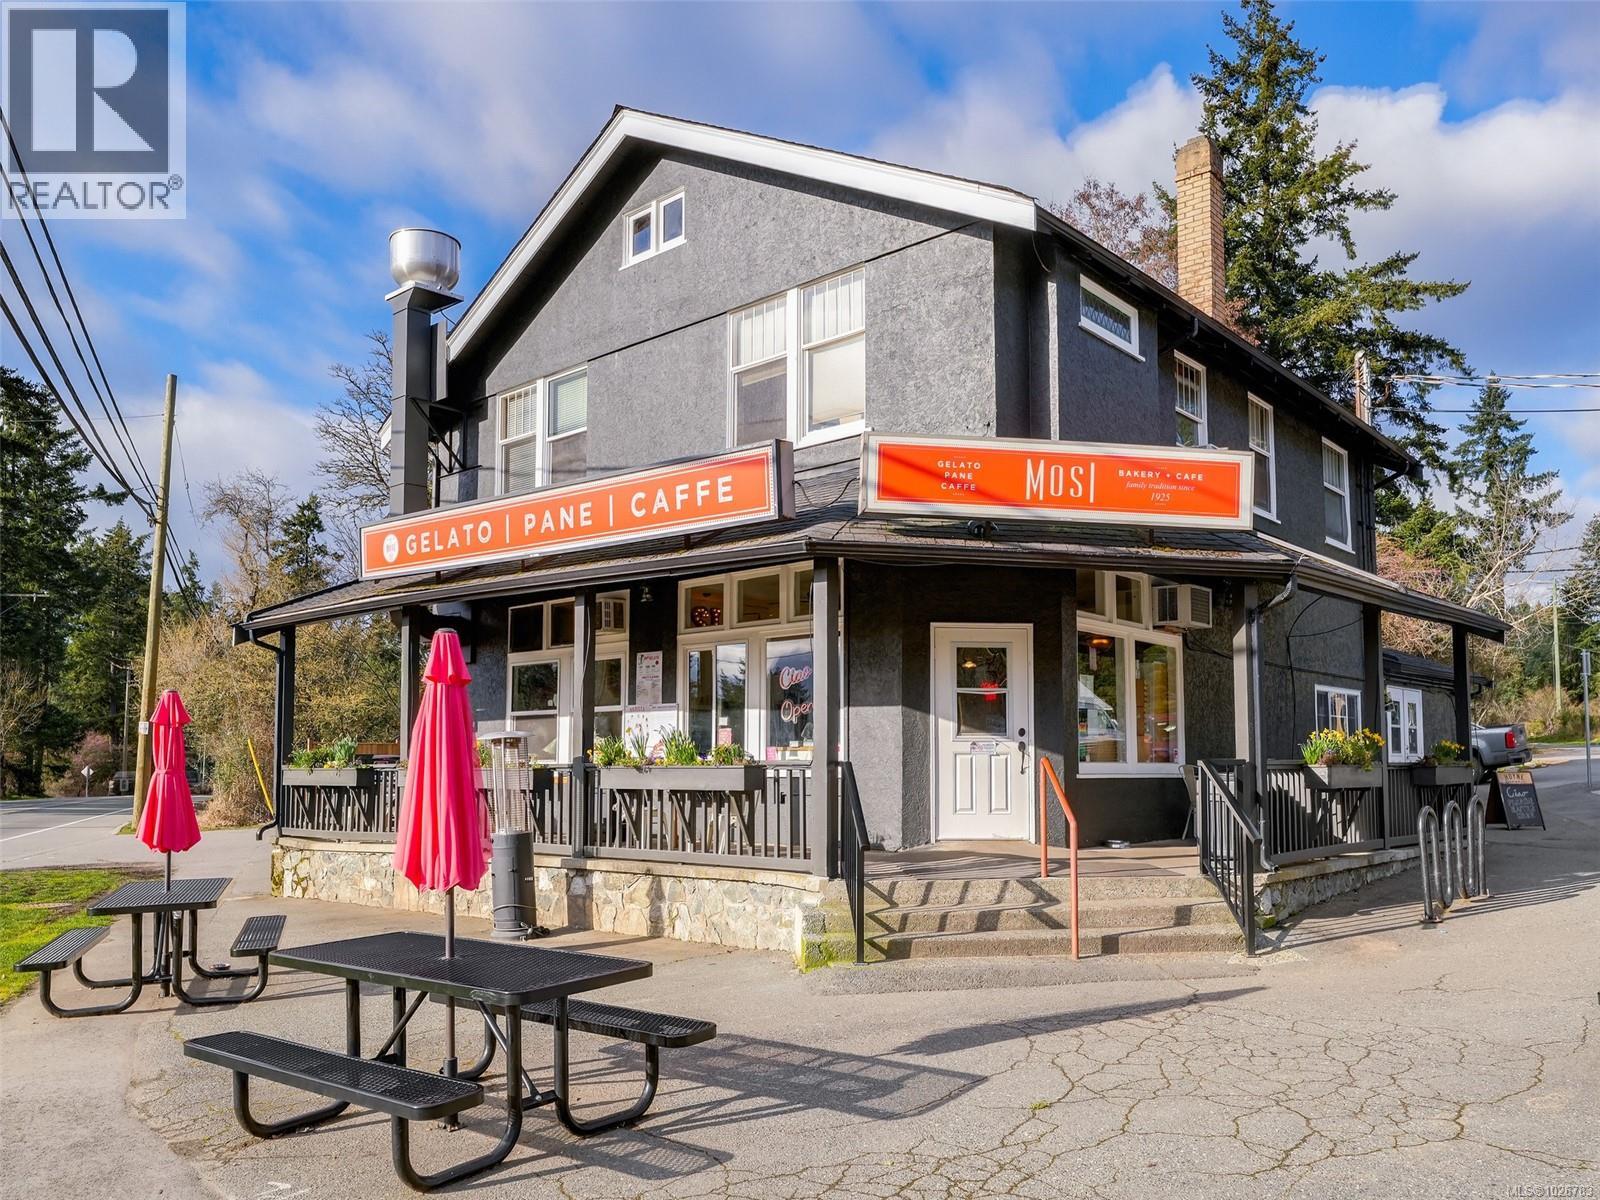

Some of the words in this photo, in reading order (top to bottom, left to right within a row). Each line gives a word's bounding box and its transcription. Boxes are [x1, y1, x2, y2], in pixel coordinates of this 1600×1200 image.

[937, 460, 981, 470] GELATO
[944, 471, 973, 480] PANE
[1118, 469, 1161, 479] BAKERY
[1175, 472, 1204, 481] CAFE
[940, 482, 976, 491] CAFFE
[1025, 458, 1096, 504] MOSI
[406, 520, 492, 556] GELATO
[524, 502, 593, 537] PANE
[630, 475, 734, 518] CAFFE
